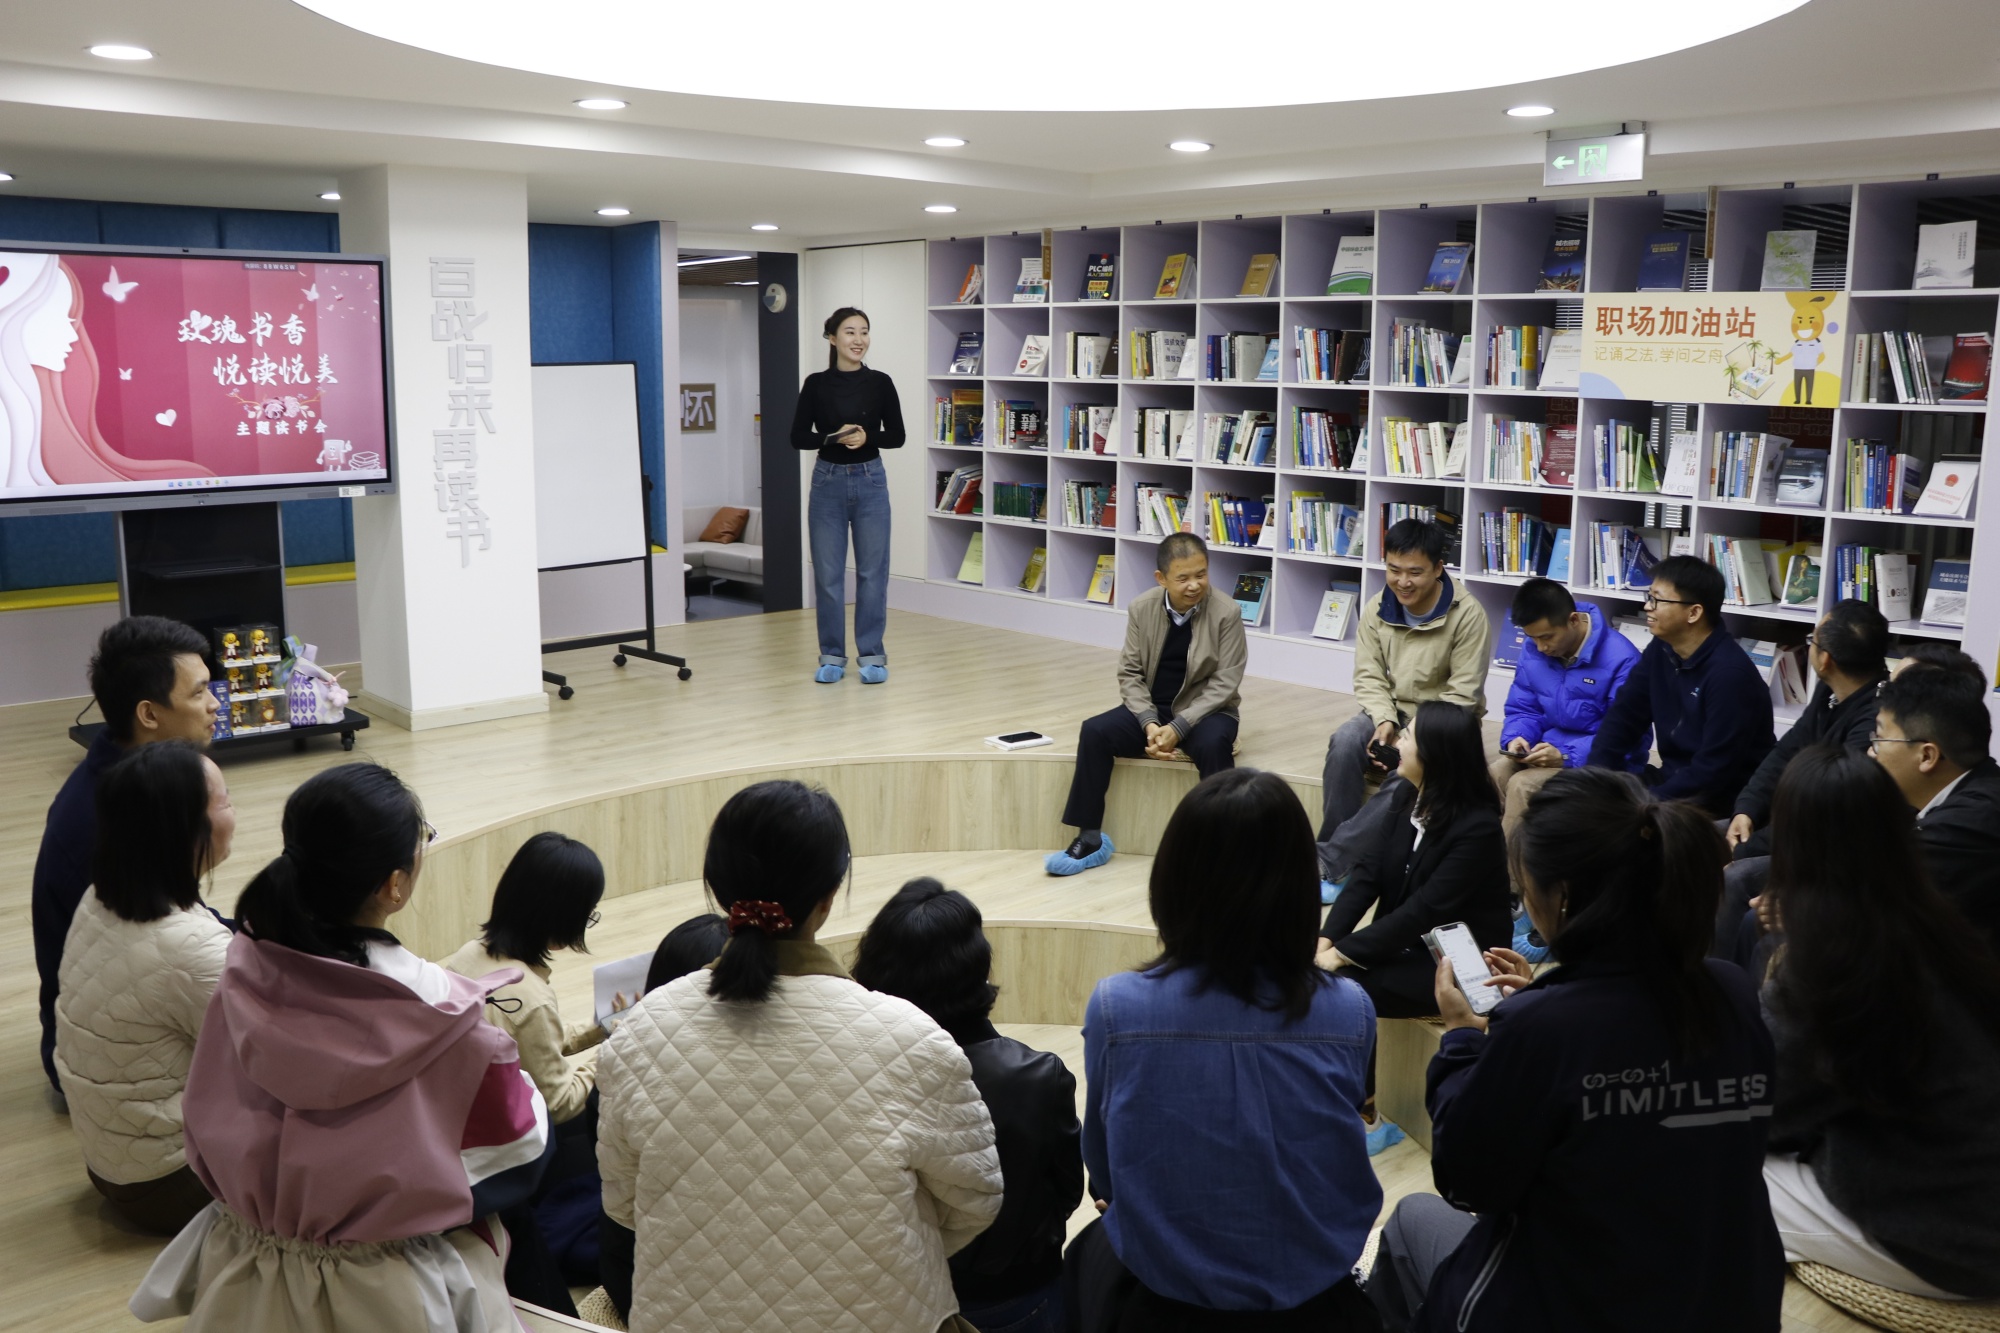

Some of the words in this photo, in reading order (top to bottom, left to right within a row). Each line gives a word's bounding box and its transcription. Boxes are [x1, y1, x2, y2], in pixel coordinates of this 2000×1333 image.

[177, 309, 307, 347] 玫瑰书香
[1595, 305, 1757, 339] 职场加油站
[212, 352, 340, 387] 悦读悦美
[236, 419, 329, 437] 主题读书会
[1582, 1073, 1768, 1121] LIMITLESS
